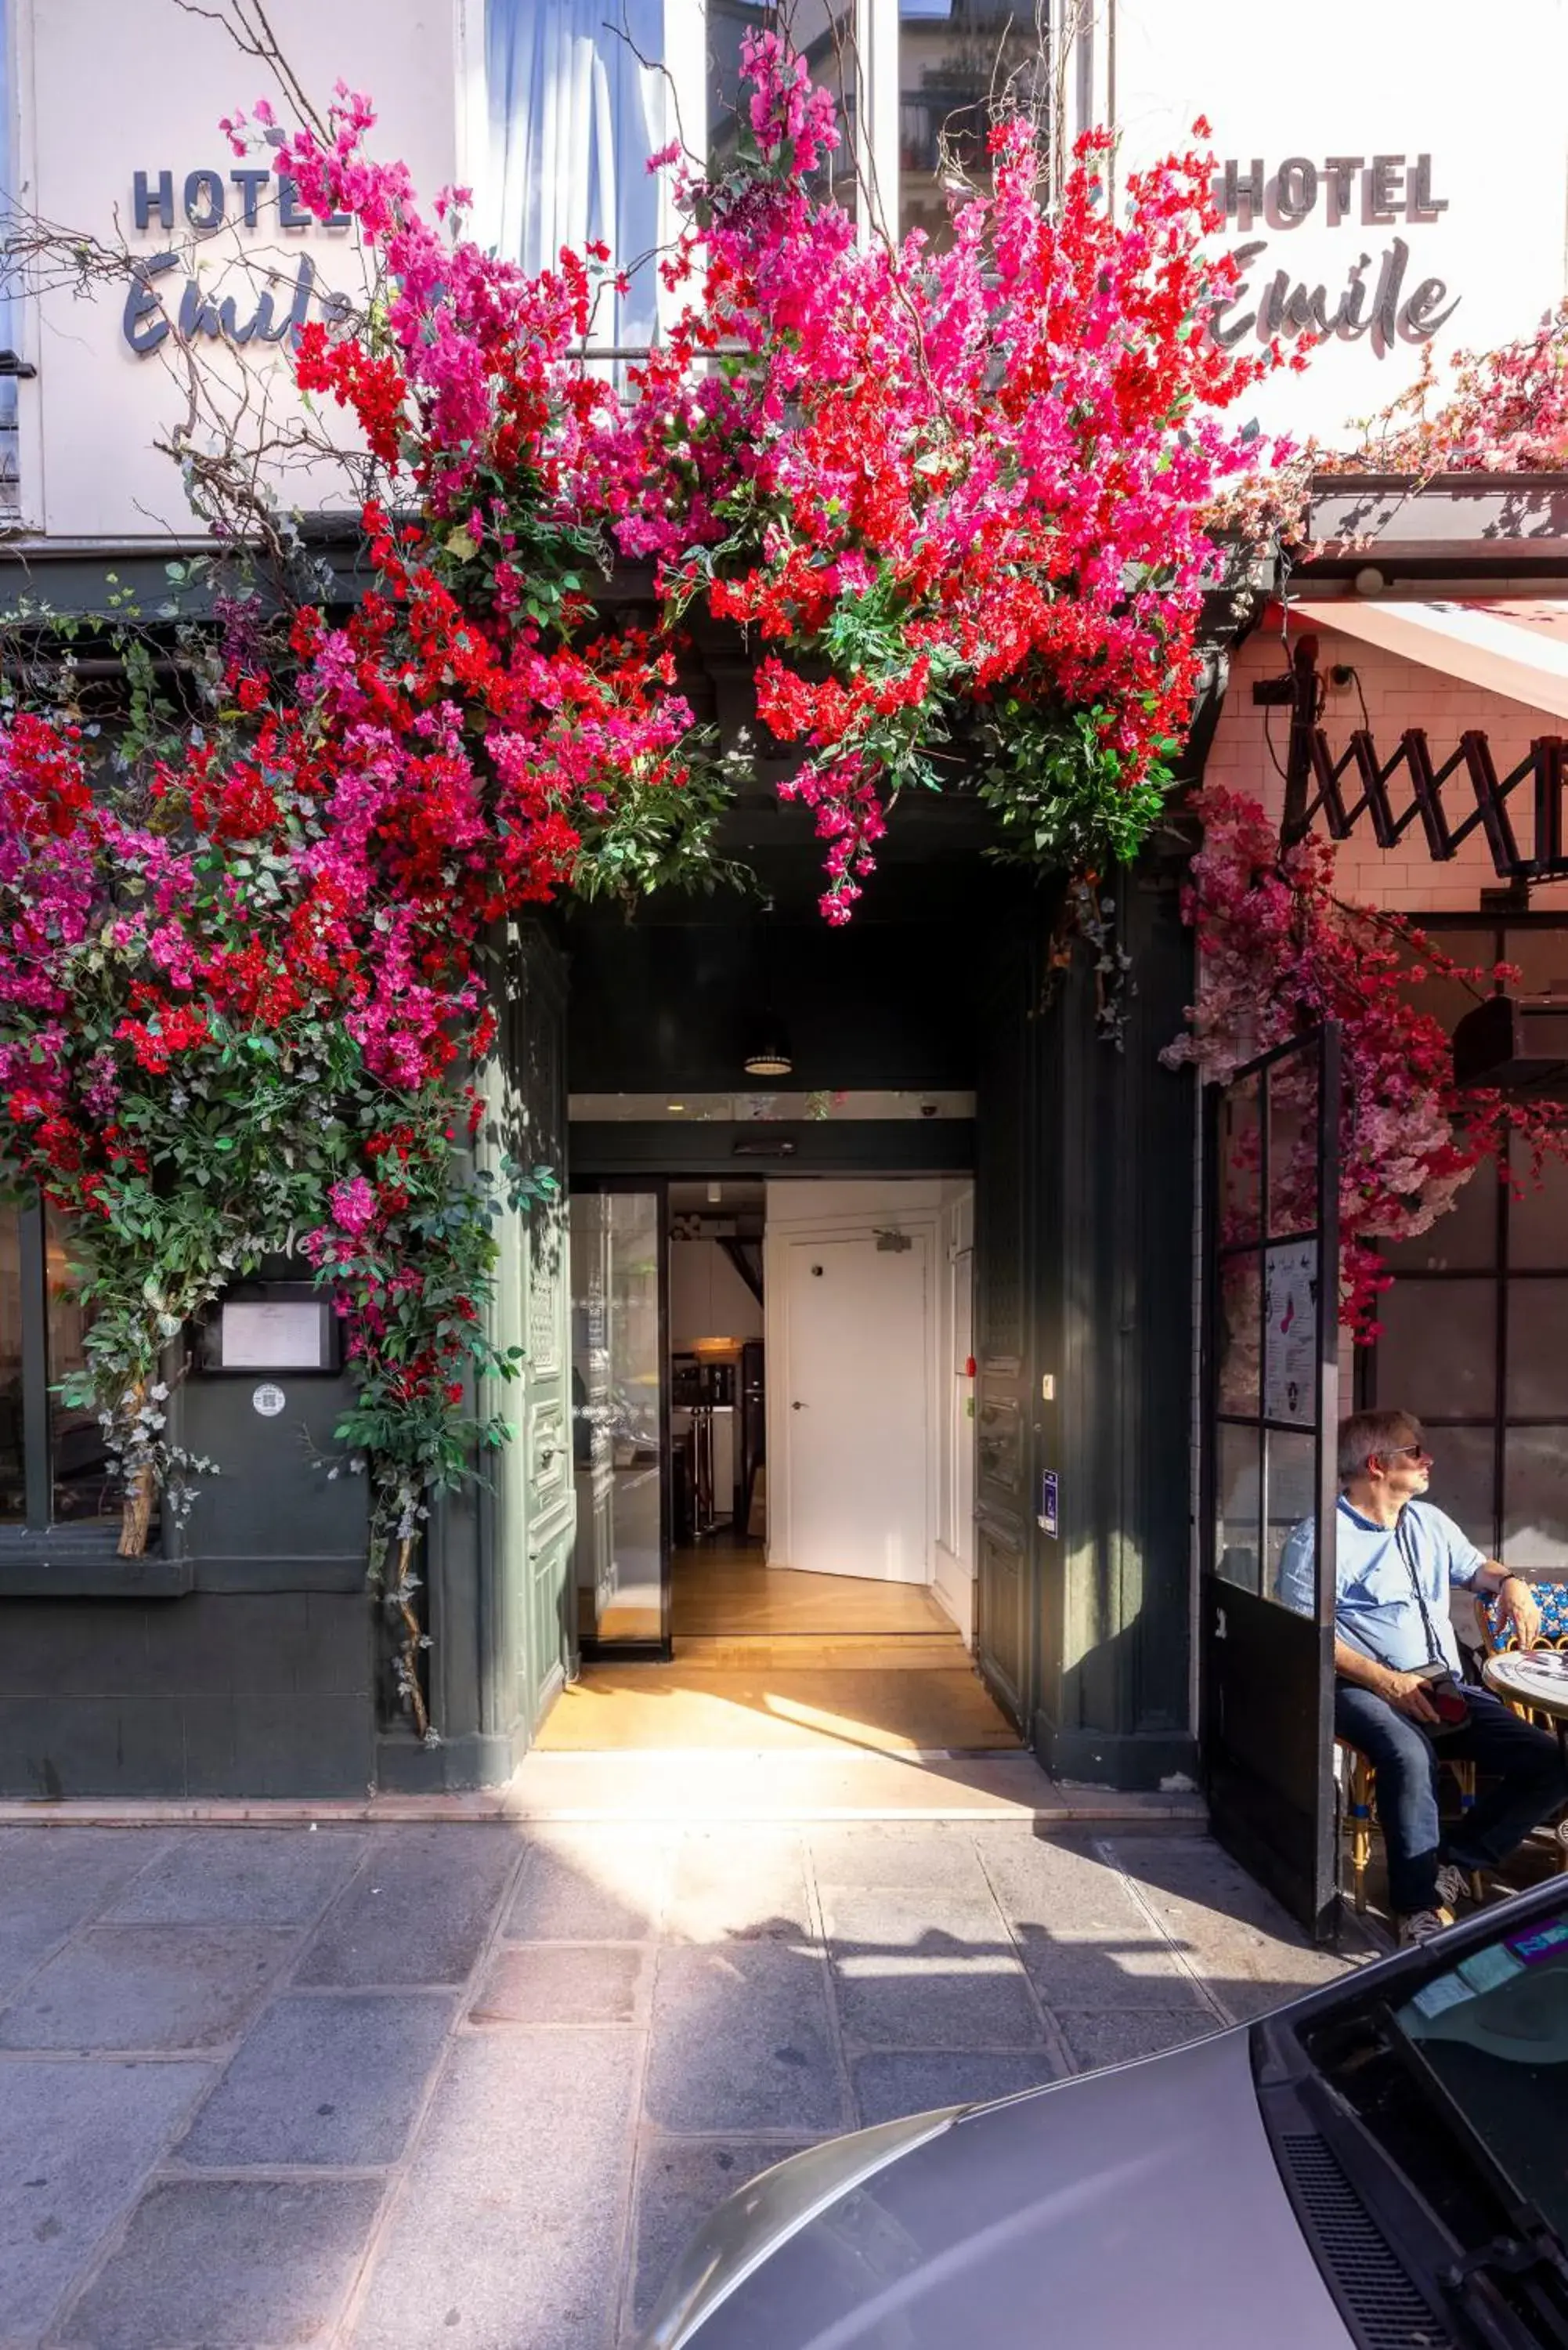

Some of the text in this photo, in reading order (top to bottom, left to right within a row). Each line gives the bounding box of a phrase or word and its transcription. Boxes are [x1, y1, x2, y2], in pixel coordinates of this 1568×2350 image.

[133, 169, 352, 230] HOTE
[1224, 154, 1449, 217] HOTEL
[1209, 237, 1462, 349] Emile
